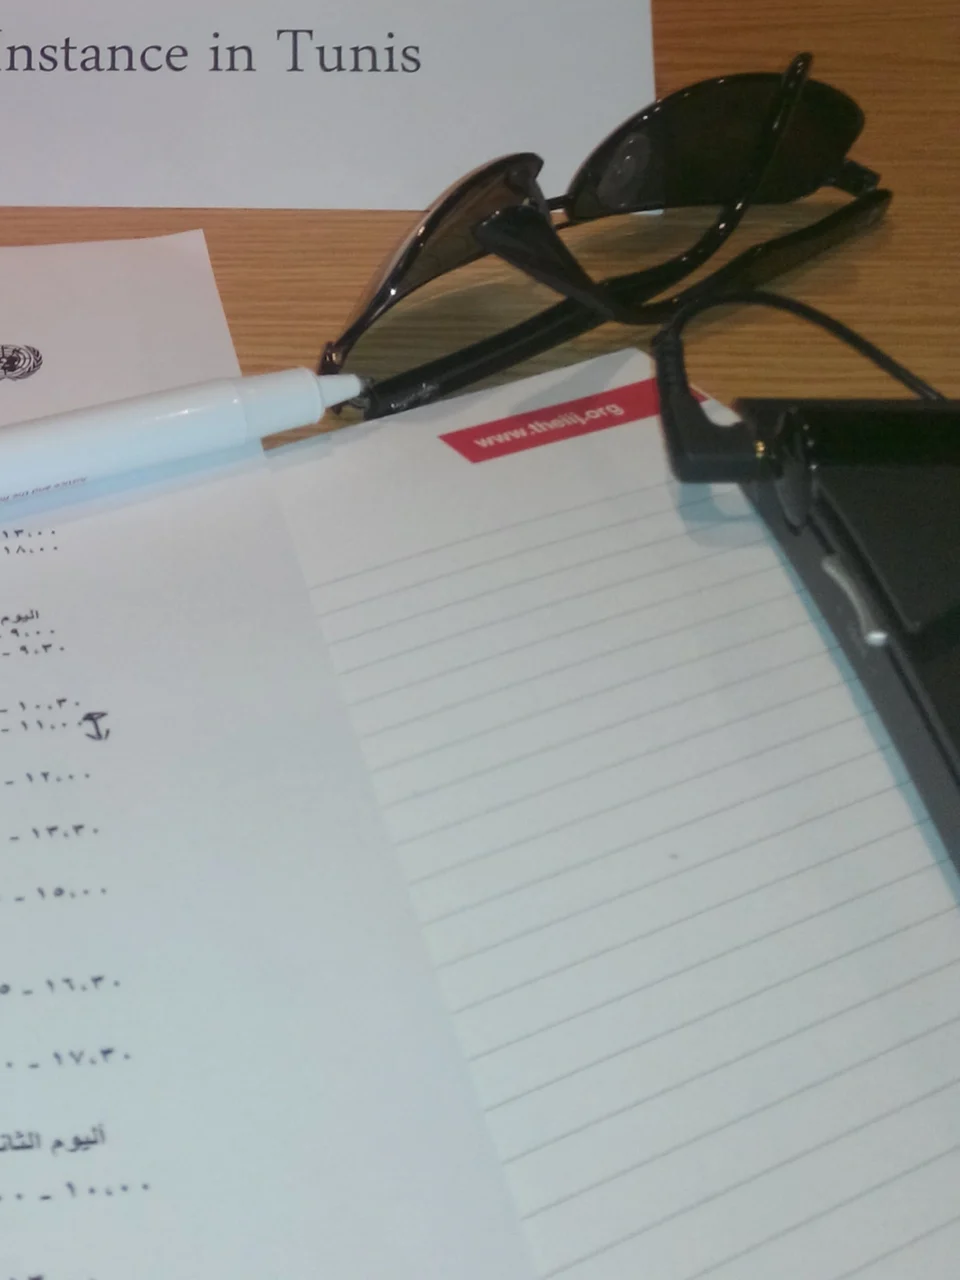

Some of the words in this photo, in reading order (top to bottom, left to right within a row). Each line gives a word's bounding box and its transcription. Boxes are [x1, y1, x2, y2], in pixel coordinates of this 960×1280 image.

[208, 31, 257, 73] in
[275, 28, 422, 74] Tunis
[473, 402, 626, 450] www.theiij.org
[0, 608, 40, 627] اليوم
